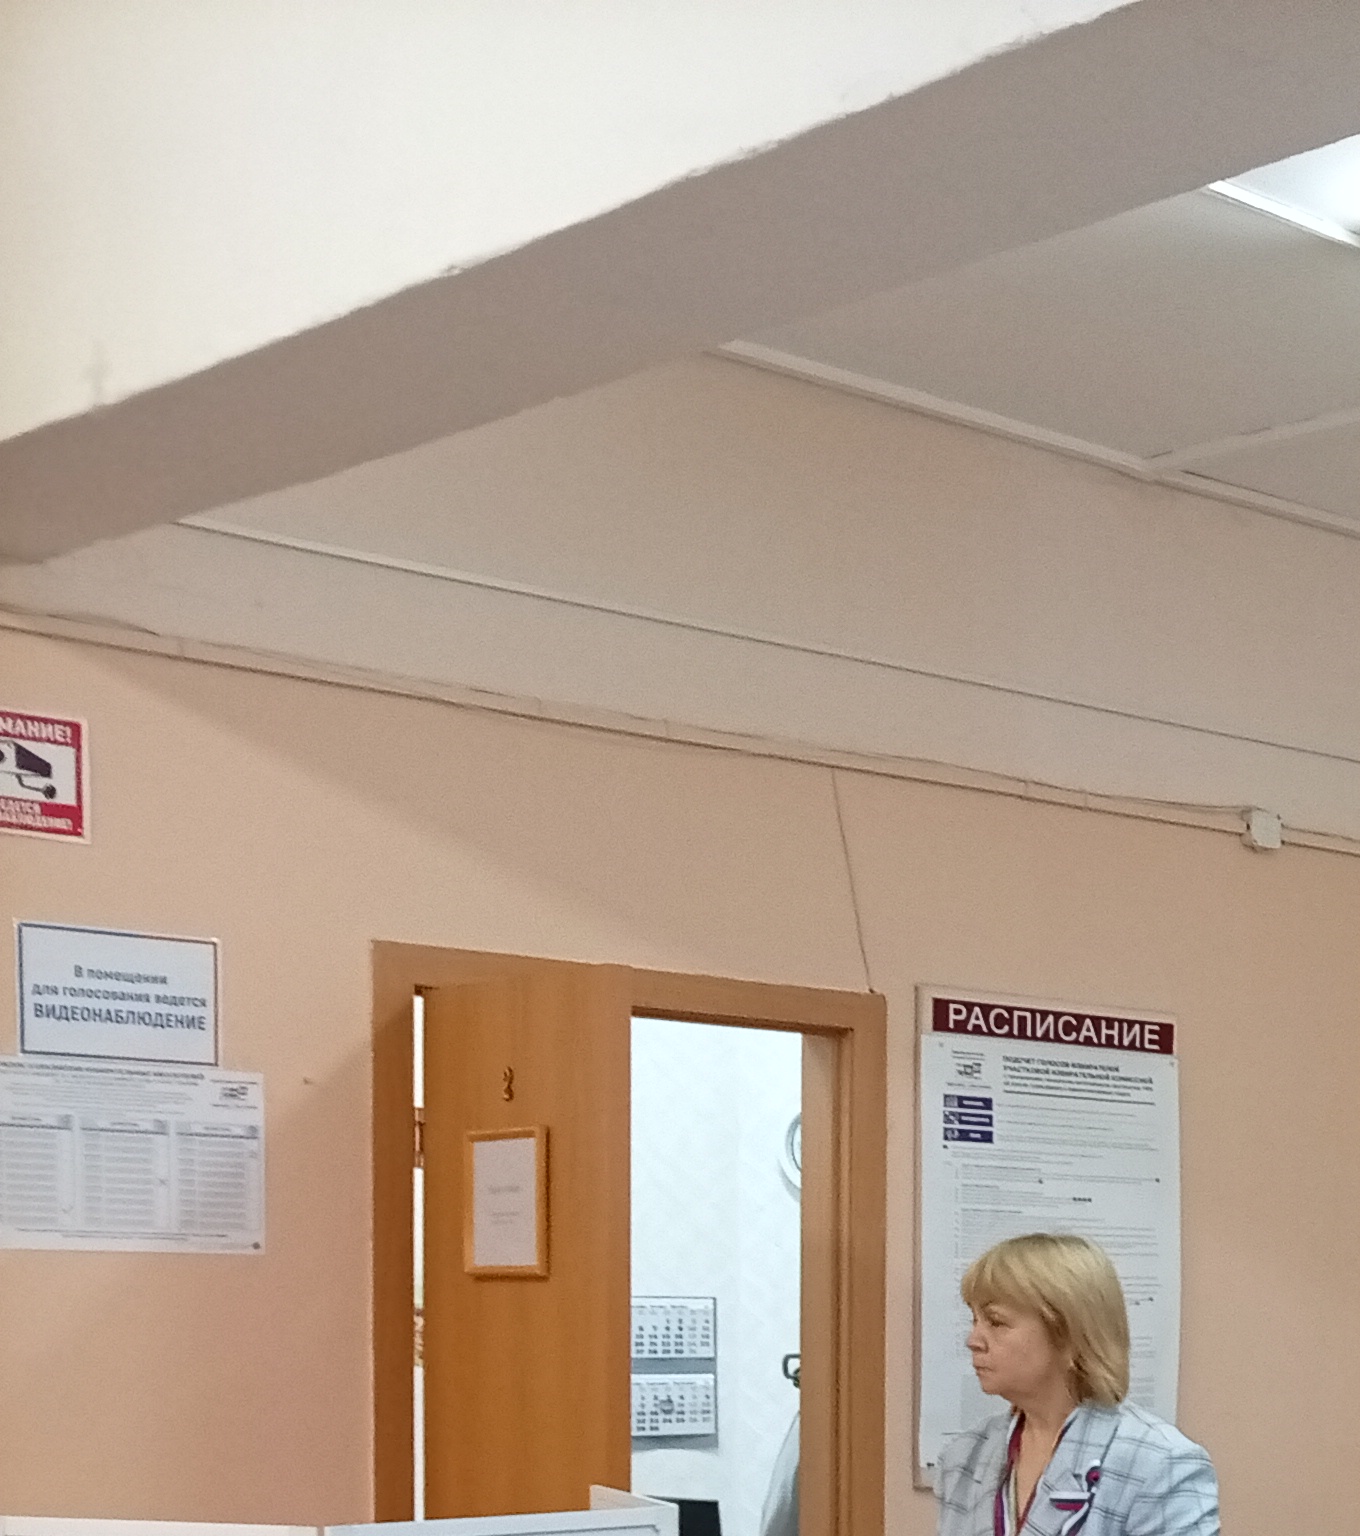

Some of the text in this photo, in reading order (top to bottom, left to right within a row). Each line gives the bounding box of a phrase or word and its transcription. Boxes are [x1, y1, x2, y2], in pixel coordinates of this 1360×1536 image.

[87, 968, 168, 985] помещении
[32, 984, 59, 996] для
[62, 986, 150, 1003] голосования
[34, 1003, 206, 1031] ВИДЕОНАБЛЮДЕНИЕ
[948, 1003, 1161, 1050] РАСПИСАНИЕ
